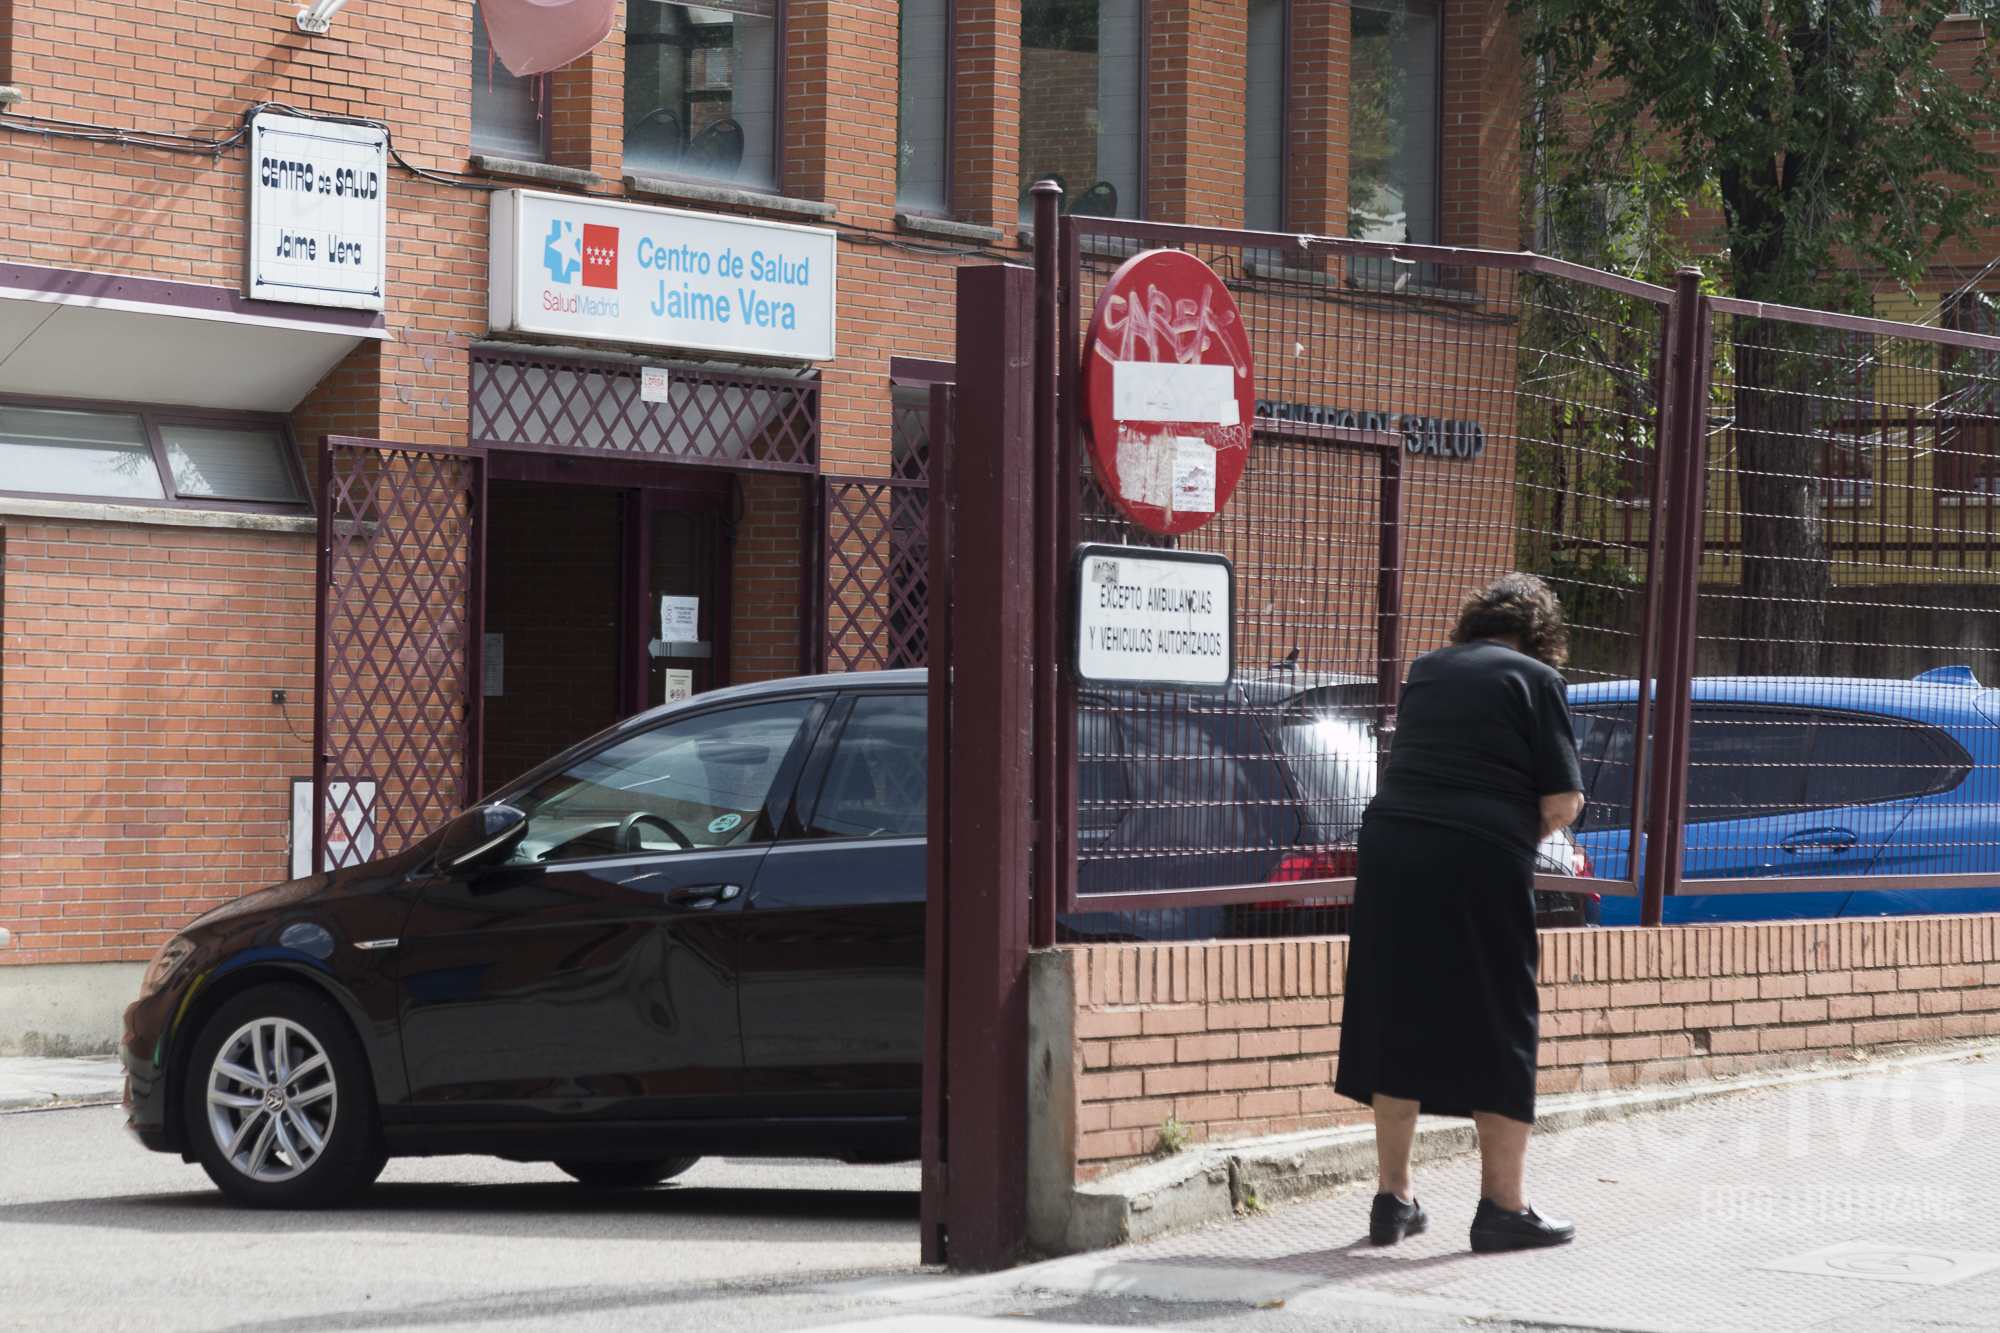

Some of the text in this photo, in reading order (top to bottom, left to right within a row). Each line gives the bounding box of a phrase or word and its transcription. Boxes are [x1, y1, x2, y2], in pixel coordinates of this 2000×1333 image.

[262, 157, 377, 200] CENTRO de SALUD
[277, 229, 362, 265] Jaime Vera
[637, 237, 809, 286] Centro de Salud
[543, 290, 620, 318] SaludMadrid
[651, 279, 796, 330] Jaime Vera
[1400, 414, 1486, 459] SALUD
[1100, 584, 1212, 614] EXCEPTO AMBULANCIAS
[1089, 626, 1222, 656] Y VEHICULOS AUTORIZADOS
